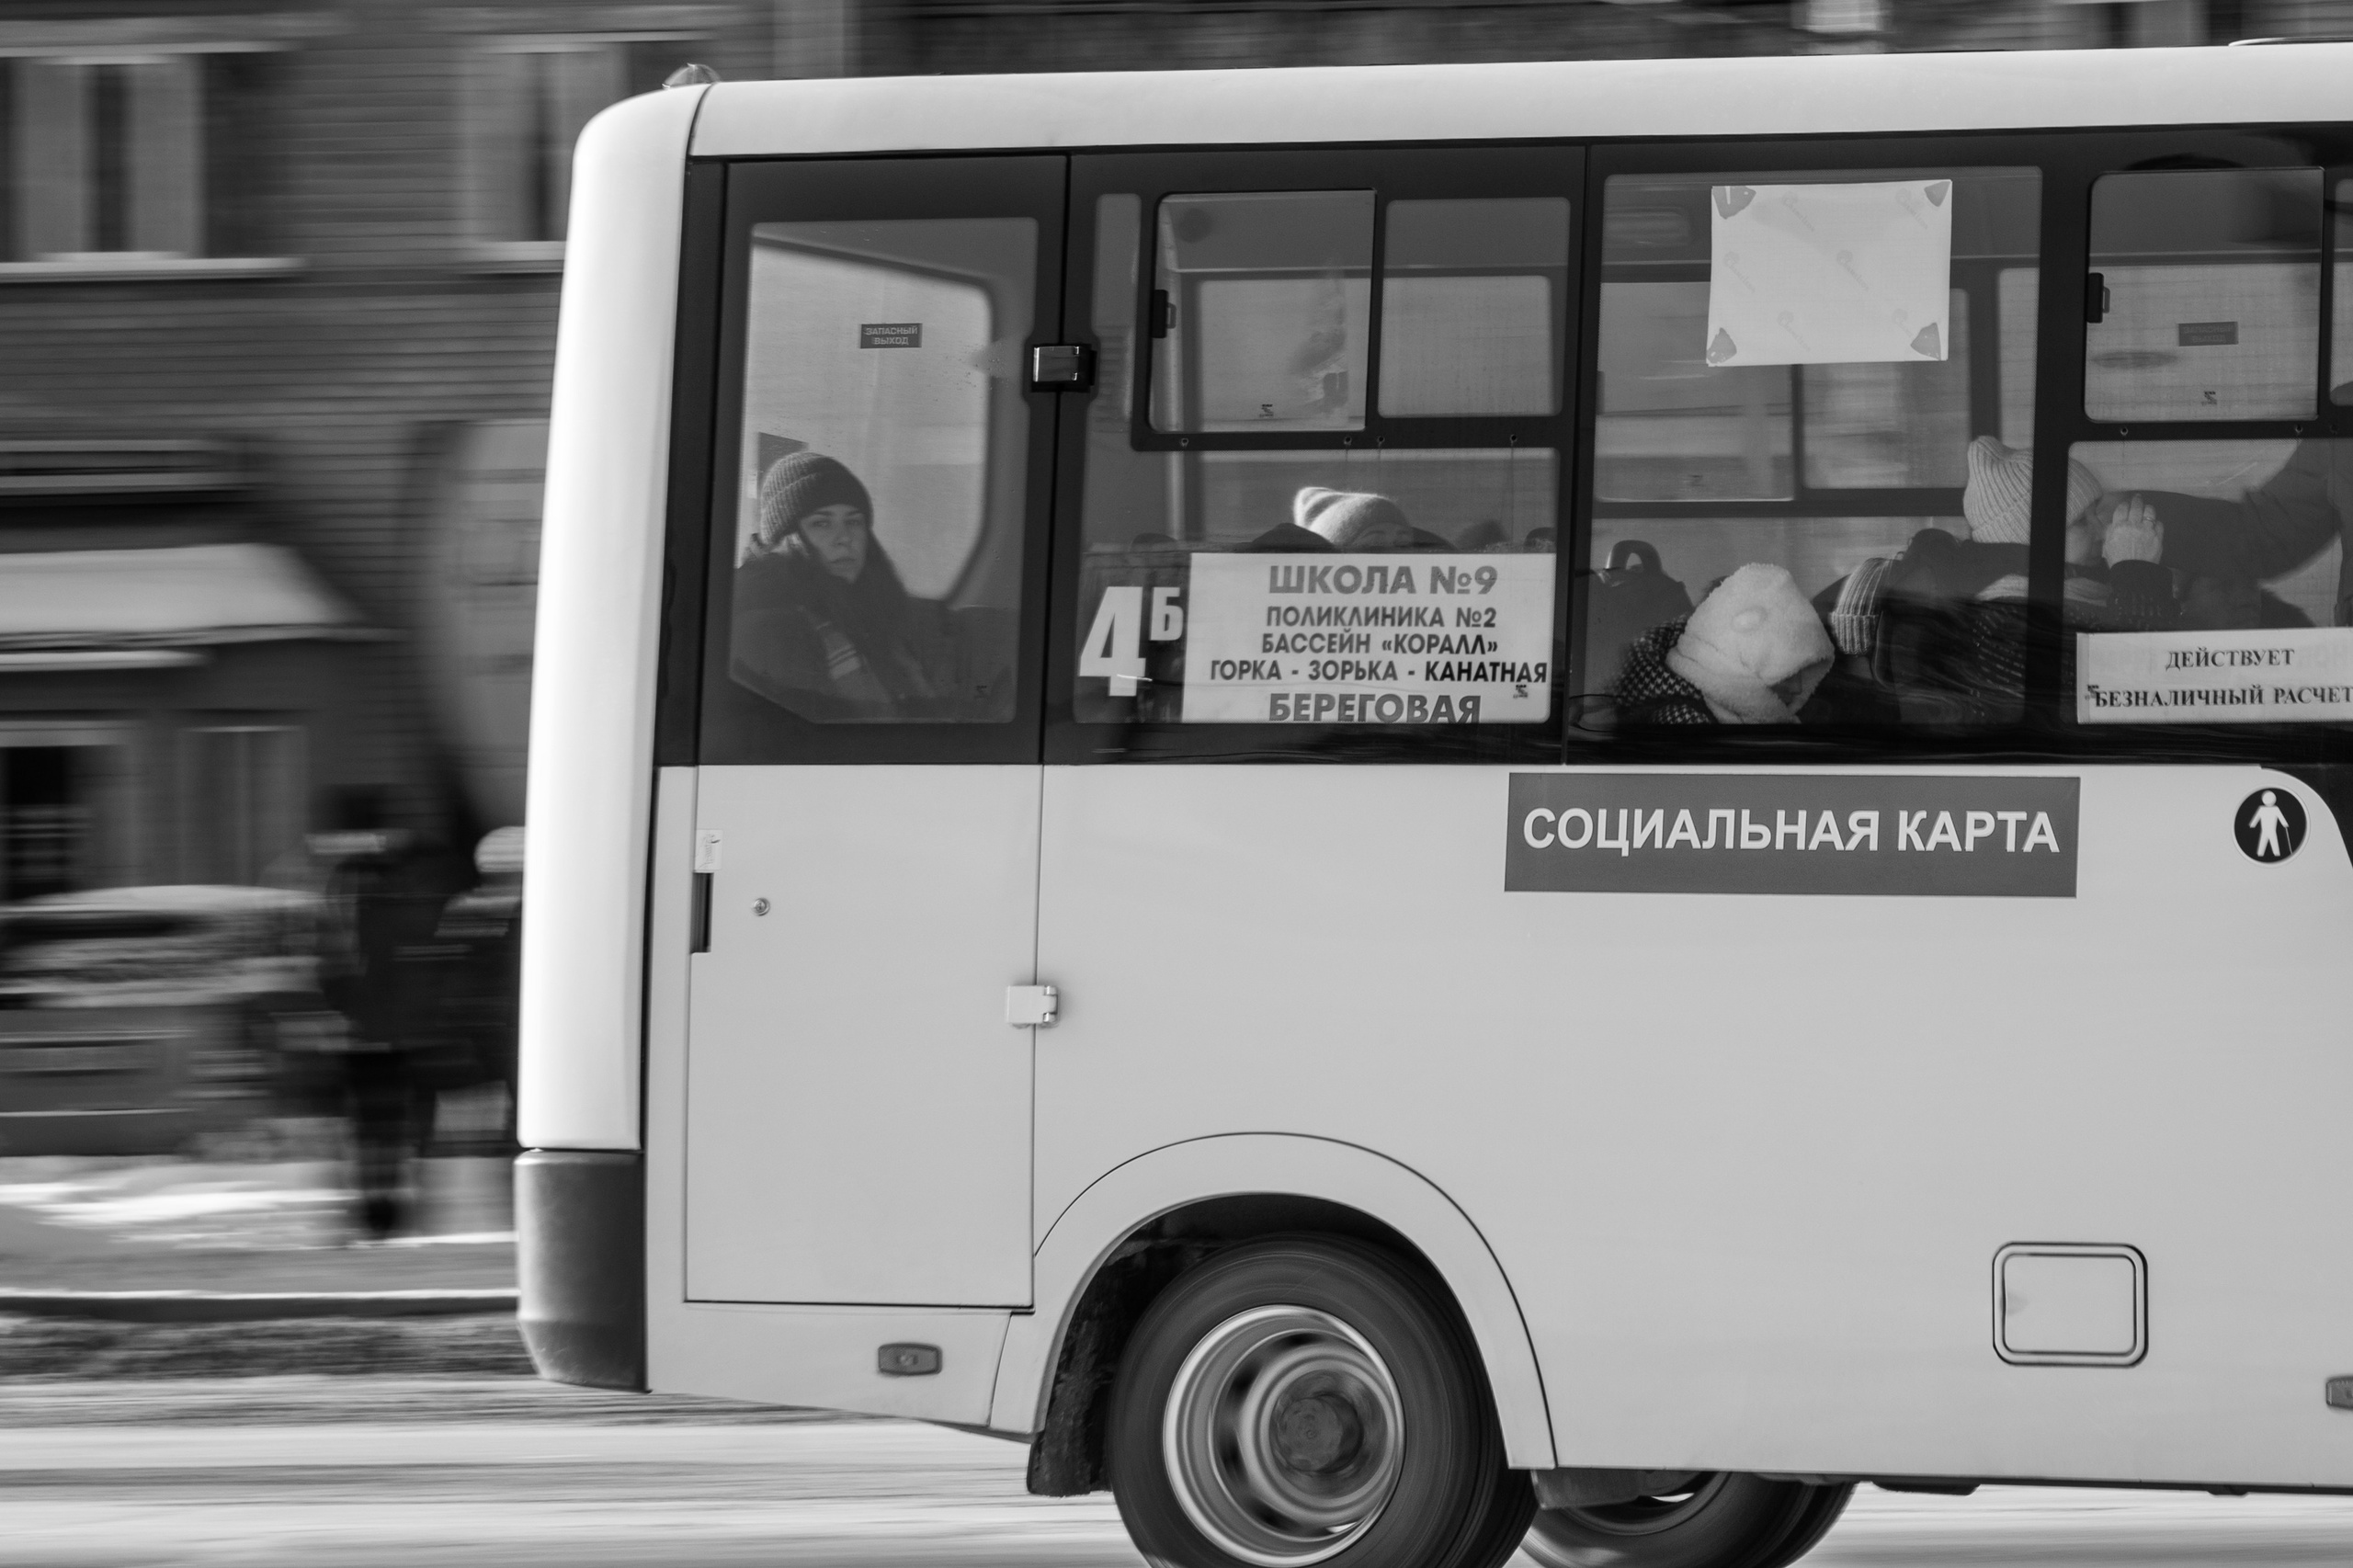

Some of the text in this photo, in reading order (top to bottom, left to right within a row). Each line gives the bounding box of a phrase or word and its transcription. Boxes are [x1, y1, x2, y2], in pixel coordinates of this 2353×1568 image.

[865, 325, 918, 335] ЗАПАСНЫЙ
[873, 336, 909, 346] ВЫХОД
[1268, 565, 1498, 595] ШКОЛА №9
[1267, 607, 1497, 629] ПОЛИКЛИНИКА №2
[1262, 628, 1499, 655] БАССЕЙН «КОРАЛЛ»
[2165, 647, 2295, 671] ДЕЙСТВУЕТ
[1211, 660, 1282, 681] ГОРКА
[1308, 660, 1399, 681] ЗОРЬКА
[1425, 662, 1548, 683] КАНАТНАЯ
[1268, 693, 1482, 722] БЕРЕГОВАЯ
[2095, 685, 2264, 708] БЕЗНАЛИЧНЫЙ
[2274, 687, 2353, 705] РАСЧЕТ
[1523, 807, 2061, 857] СОЦИАЛЬНАЯ КАРТА
